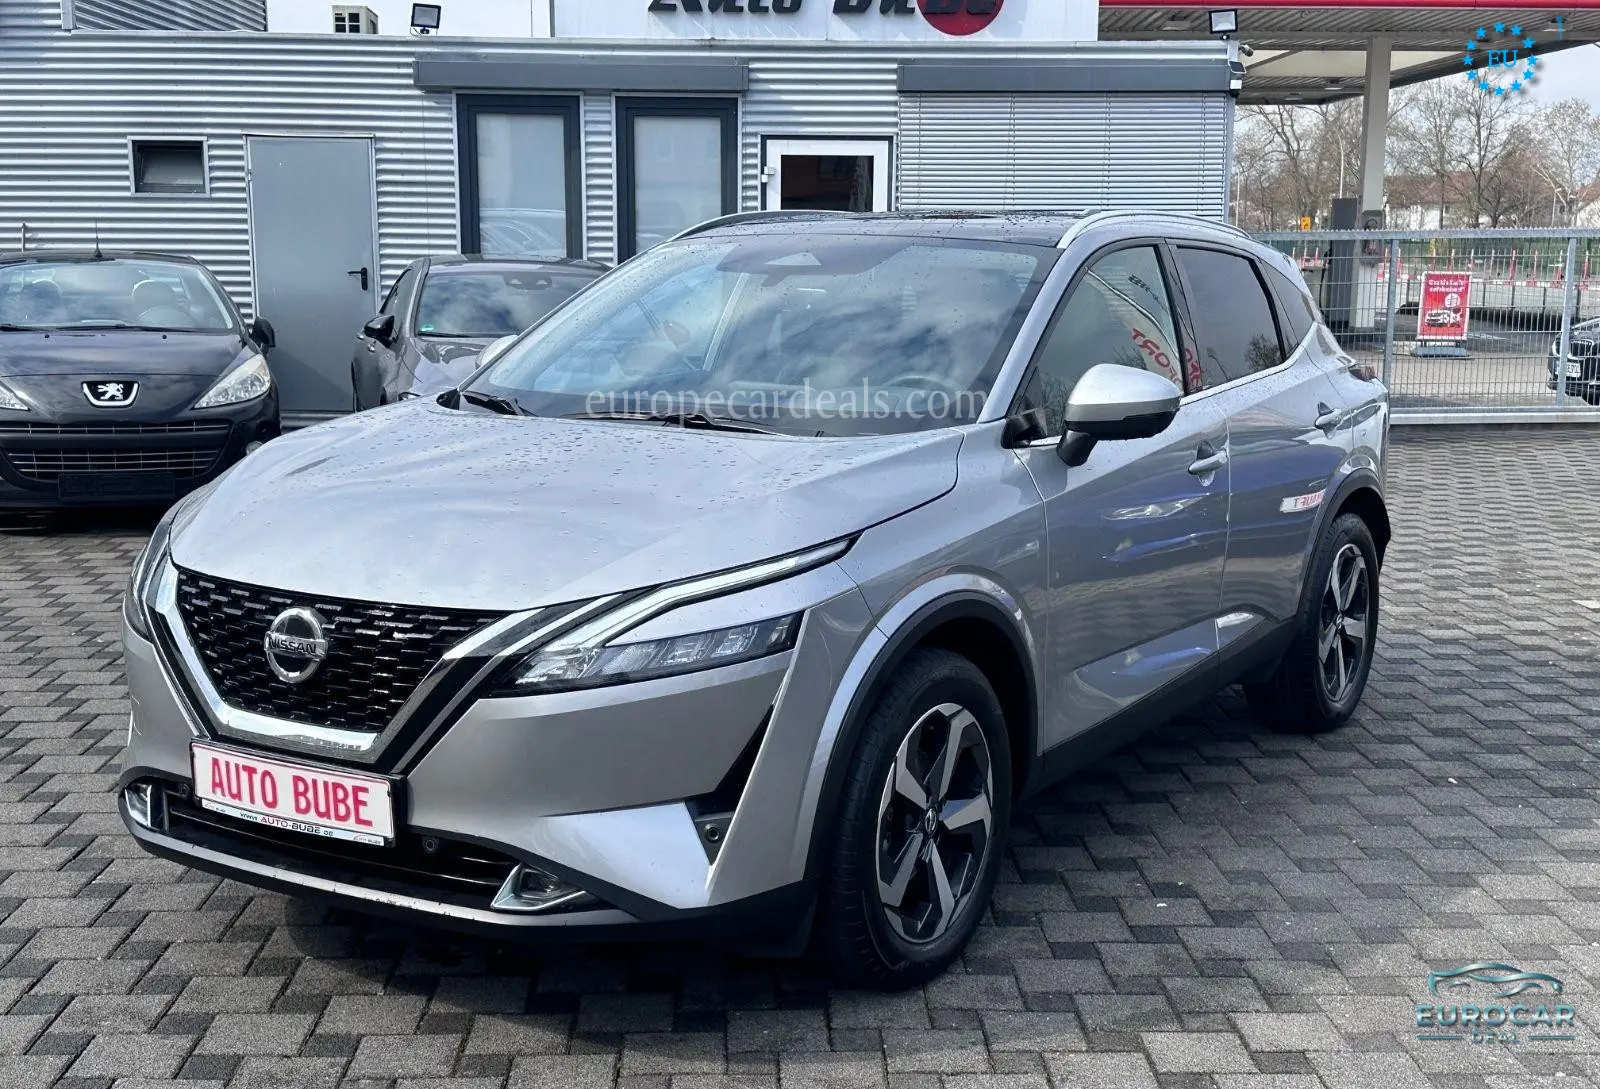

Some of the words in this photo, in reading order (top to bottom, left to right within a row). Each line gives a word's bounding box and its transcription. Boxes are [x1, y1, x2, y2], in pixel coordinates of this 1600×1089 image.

[269, 637, 317, 654] NISSAN
[210, 757, 279, 809] AUTO
[292, 774, 374, 828] BUBE
